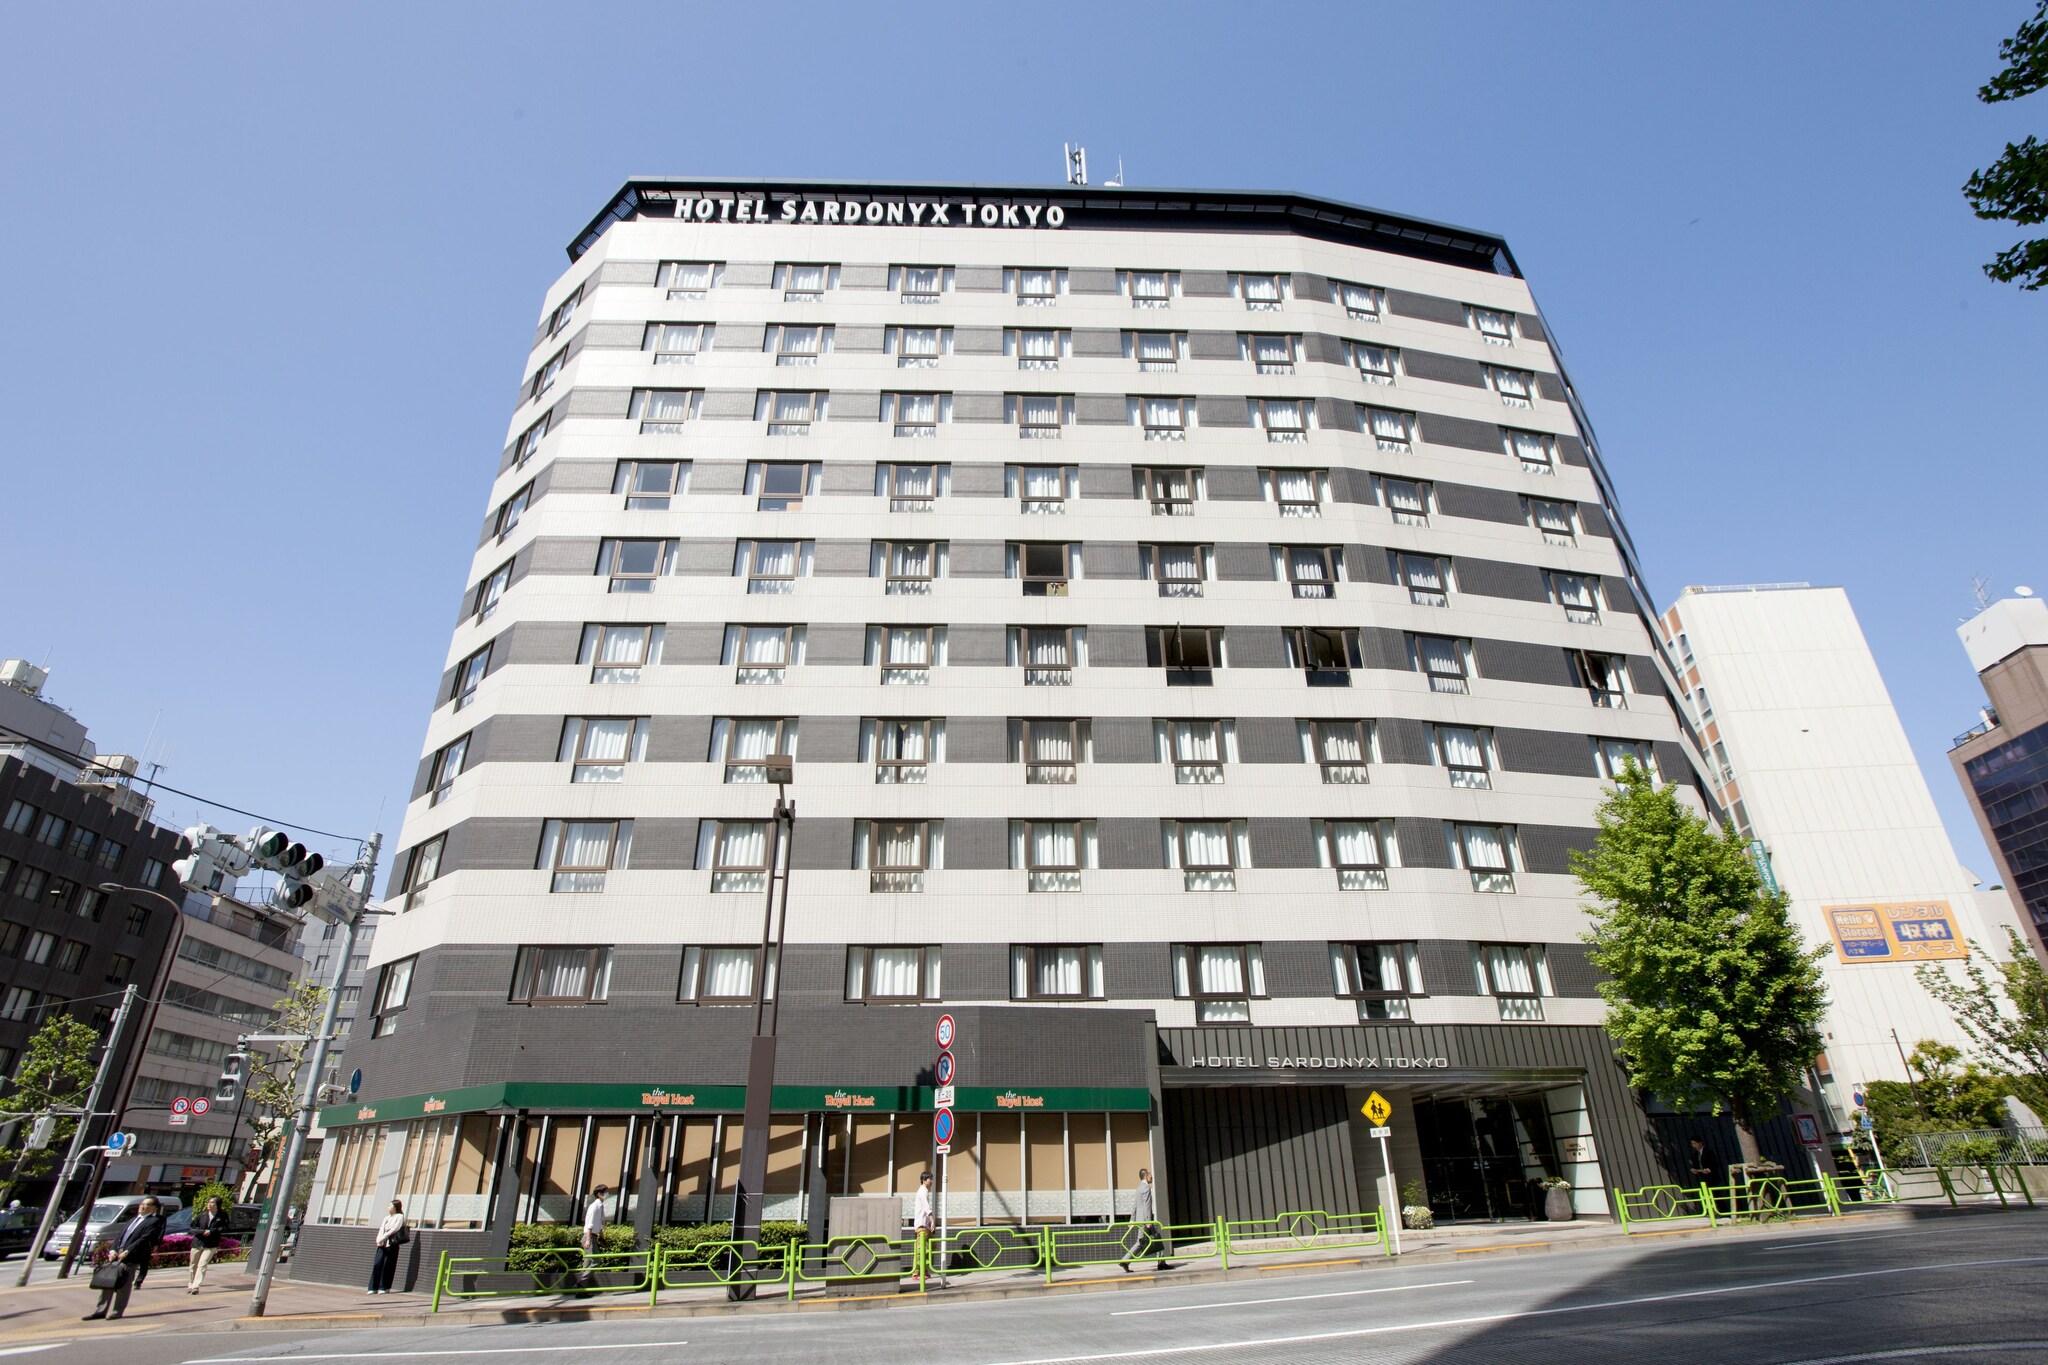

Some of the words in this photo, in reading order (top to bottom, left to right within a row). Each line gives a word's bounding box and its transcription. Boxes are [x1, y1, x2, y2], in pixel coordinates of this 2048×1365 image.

[674, 199, 769, 220] HOTEL
[781, 200, 950, 225] SARDONYX
[962, 204, 1065, 228] TOKYO
[1886, 905, 1944, 918] レンタル
[1835, 914, 1863, 925] Hello
[1900, 921, 1948, 939] 収納
[1902, 942, 1960, 956] スペース
[940, 1024, 951, 1040] 50
[1192, 1056, 1260, 1068] HOTEL
[1268, 1056, 1379, 1068] SARDONYX
[1384, 1057, 1448, 1068] TOKYO
[652, 1088, 665, 1096] the
[835, 1089, 847, 1098] the
[1006, 1090, 1017, 1099] the
[195, 1102, 206, 1110] 50
[642, 1093, 670, 1107] Royal
[671, 1094, 695, 1105] Host
[825, 1095, 851, 1108] Royal
[853, 1095, 875, 1106] Host
[997, 1096, 1021, 1108] Royal
[1022, 1096, 1044, 1106] Host
